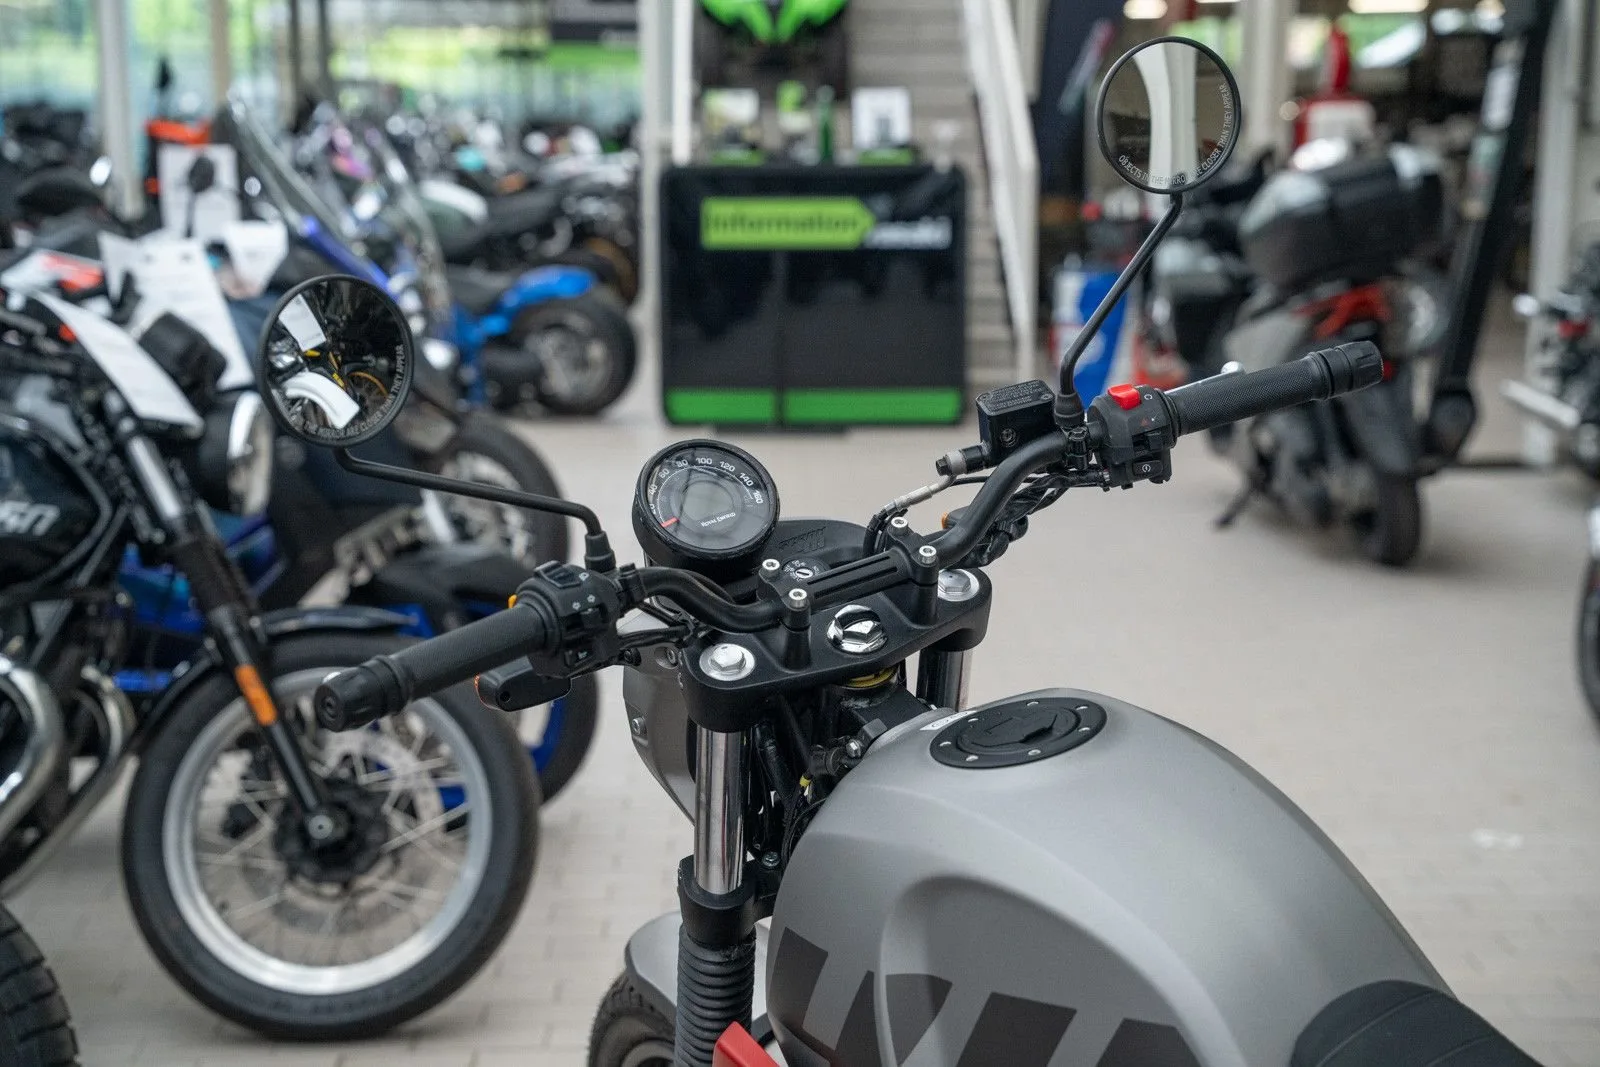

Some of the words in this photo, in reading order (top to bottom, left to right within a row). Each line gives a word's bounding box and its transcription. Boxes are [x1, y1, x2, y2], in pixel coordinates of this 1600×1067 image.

[1219, 82, 1233, 108] APPEAR
[1223, 110, 1233, 128] THEY
[1217, 129, 1230, 149] THAN
[1202, 148, 1221, 169] CLOSER
[1119, 155, 1141, 178] OBJECTS
[676, 460, 688, 468] 80
[695, 457, 713, 465] 100
[720, 461, 735, 472] 120
[660, 468, 670, 478] 60
[740, 473, 754, 486] 140
[649, 483, 658, 495] 40
[753, 490, 763, 504] 160
